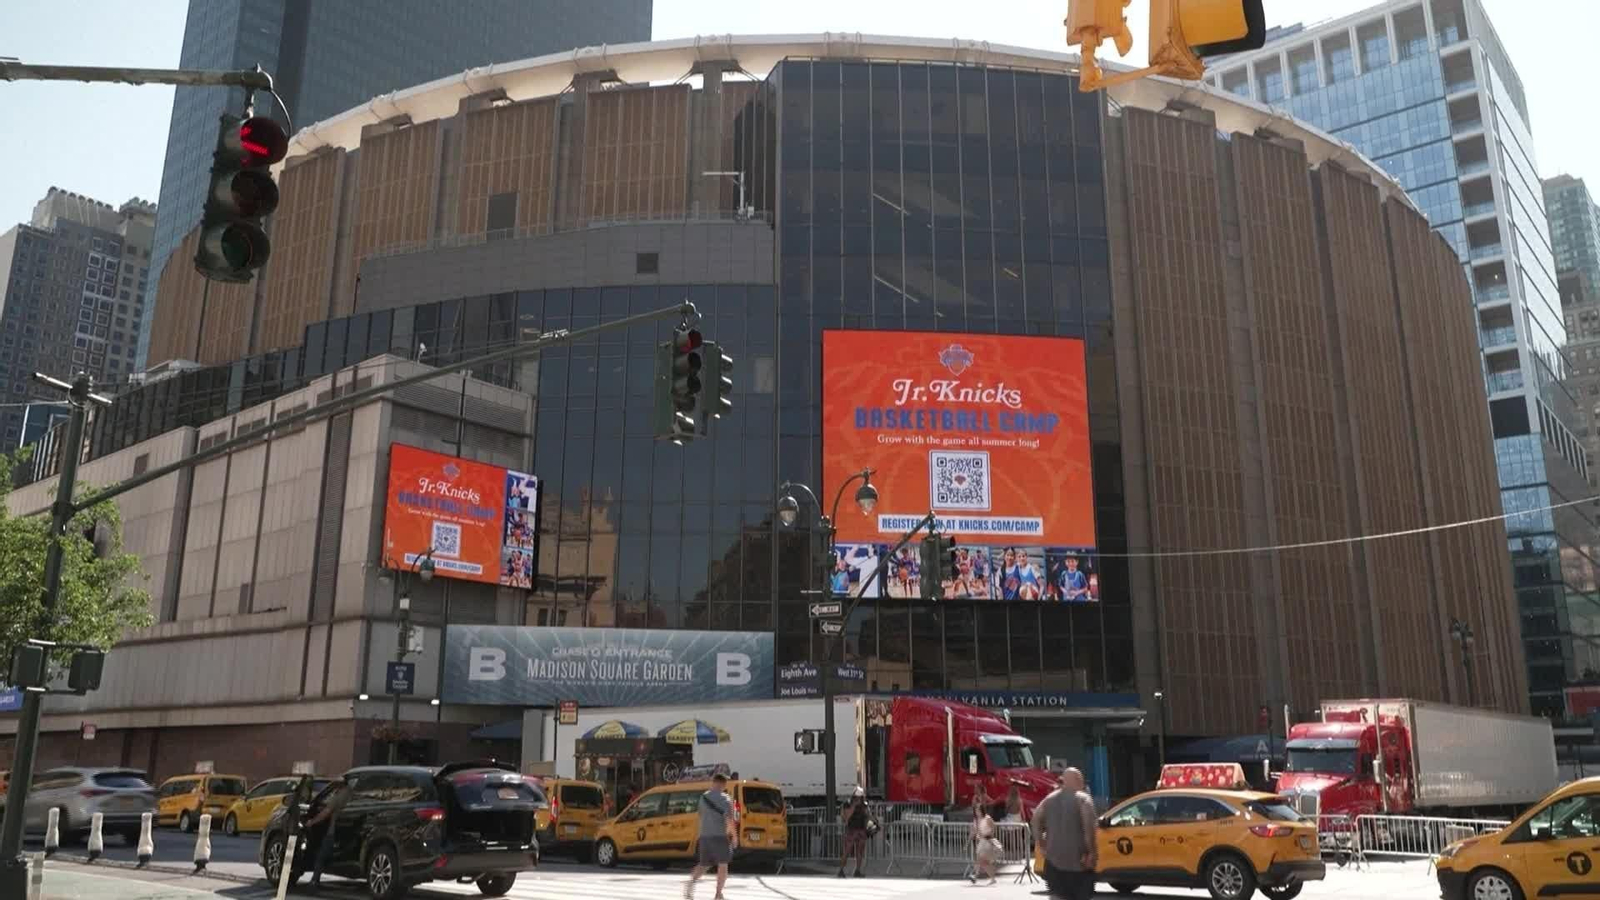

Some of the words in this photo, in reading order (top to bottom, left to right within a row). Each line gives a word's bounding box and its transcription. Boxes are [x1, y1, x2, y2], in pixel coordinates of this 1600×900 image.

[893, 379, 928, 406] Jr.
[929, 380, 1022, 409] Knicks
[854, 407, 993, 432] BASKETBALL
[998, 411, 1061, 435] CAMP
[877, 434, 903, 444] Grow
[905, 434, 924, 445] with
[926, 435, 941, 445] the
[943, 438, 966, 448] game
[968, 436, 980, 446] all
[981, 438, 1017, 447] summer
[1018, 438, 1041, 449] long!
[418, 477, 436, 494] Jr.
[437, 480, 481, 505] Knicks
[946, 519, 956, 531] AT
[958, 519, 1040, 533] KNICKS.COM/CAMP
[605, 647, 673, 659] ENTRANCE
[467, 646, 507, 682] B
[527, 658, 586, 680] MADISON
[590, 659, 639, 681] SQUARE
[643, 660, 693, 682] GARDEN
[716, 651, 752, 686] B
[781, 667, 803, 680] Eighth
[804, 667, 817, 677] Ave
[780, 687, 790, 695] Joe
[791, 686, 807, 695] Louis
[1012, 695, 1067, 706] STATION
